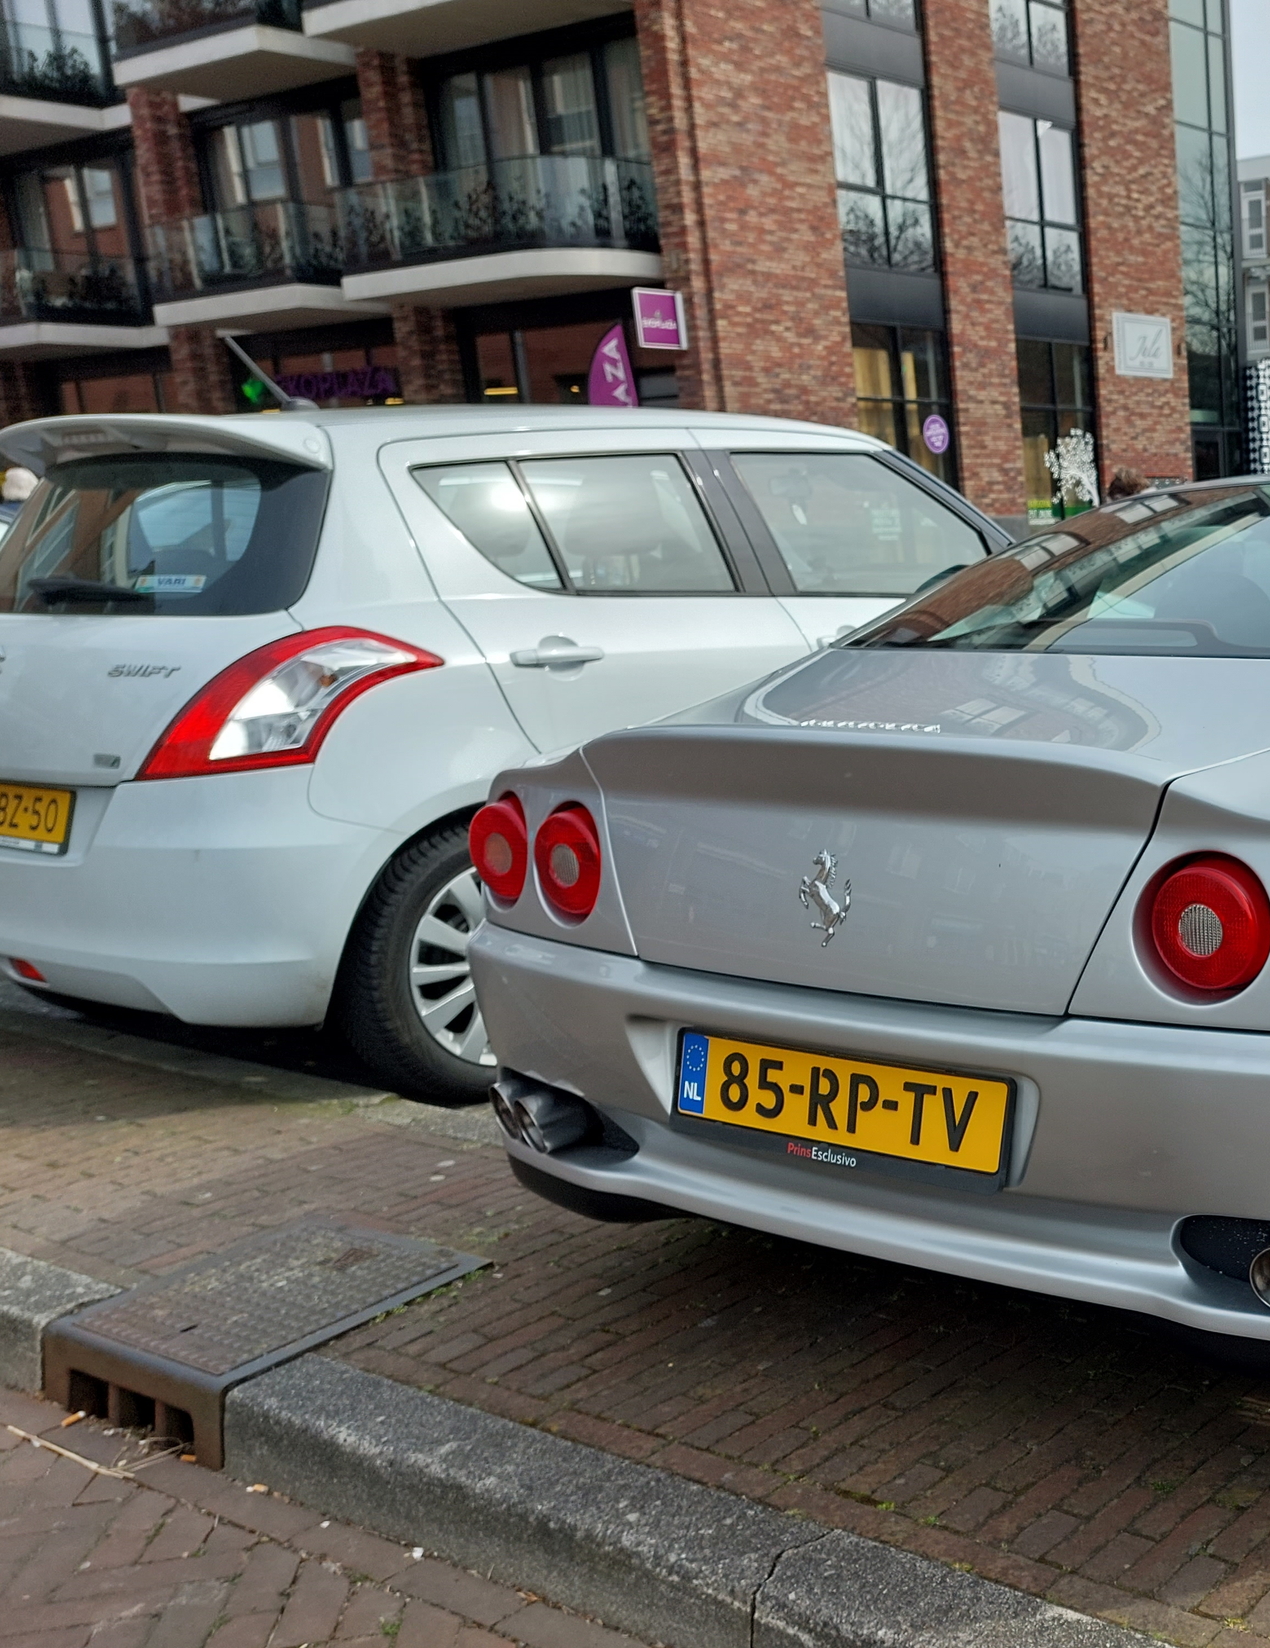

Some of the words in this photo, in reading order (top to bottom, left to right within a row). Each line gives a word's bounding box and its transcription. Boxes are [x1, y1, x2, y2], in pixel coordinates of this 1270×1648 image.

[107, 664, 181, 678] SWIFT
[683, 1081, 702, 1101] NL
[719, 1052, 979, 1153] 85-RP-TV
